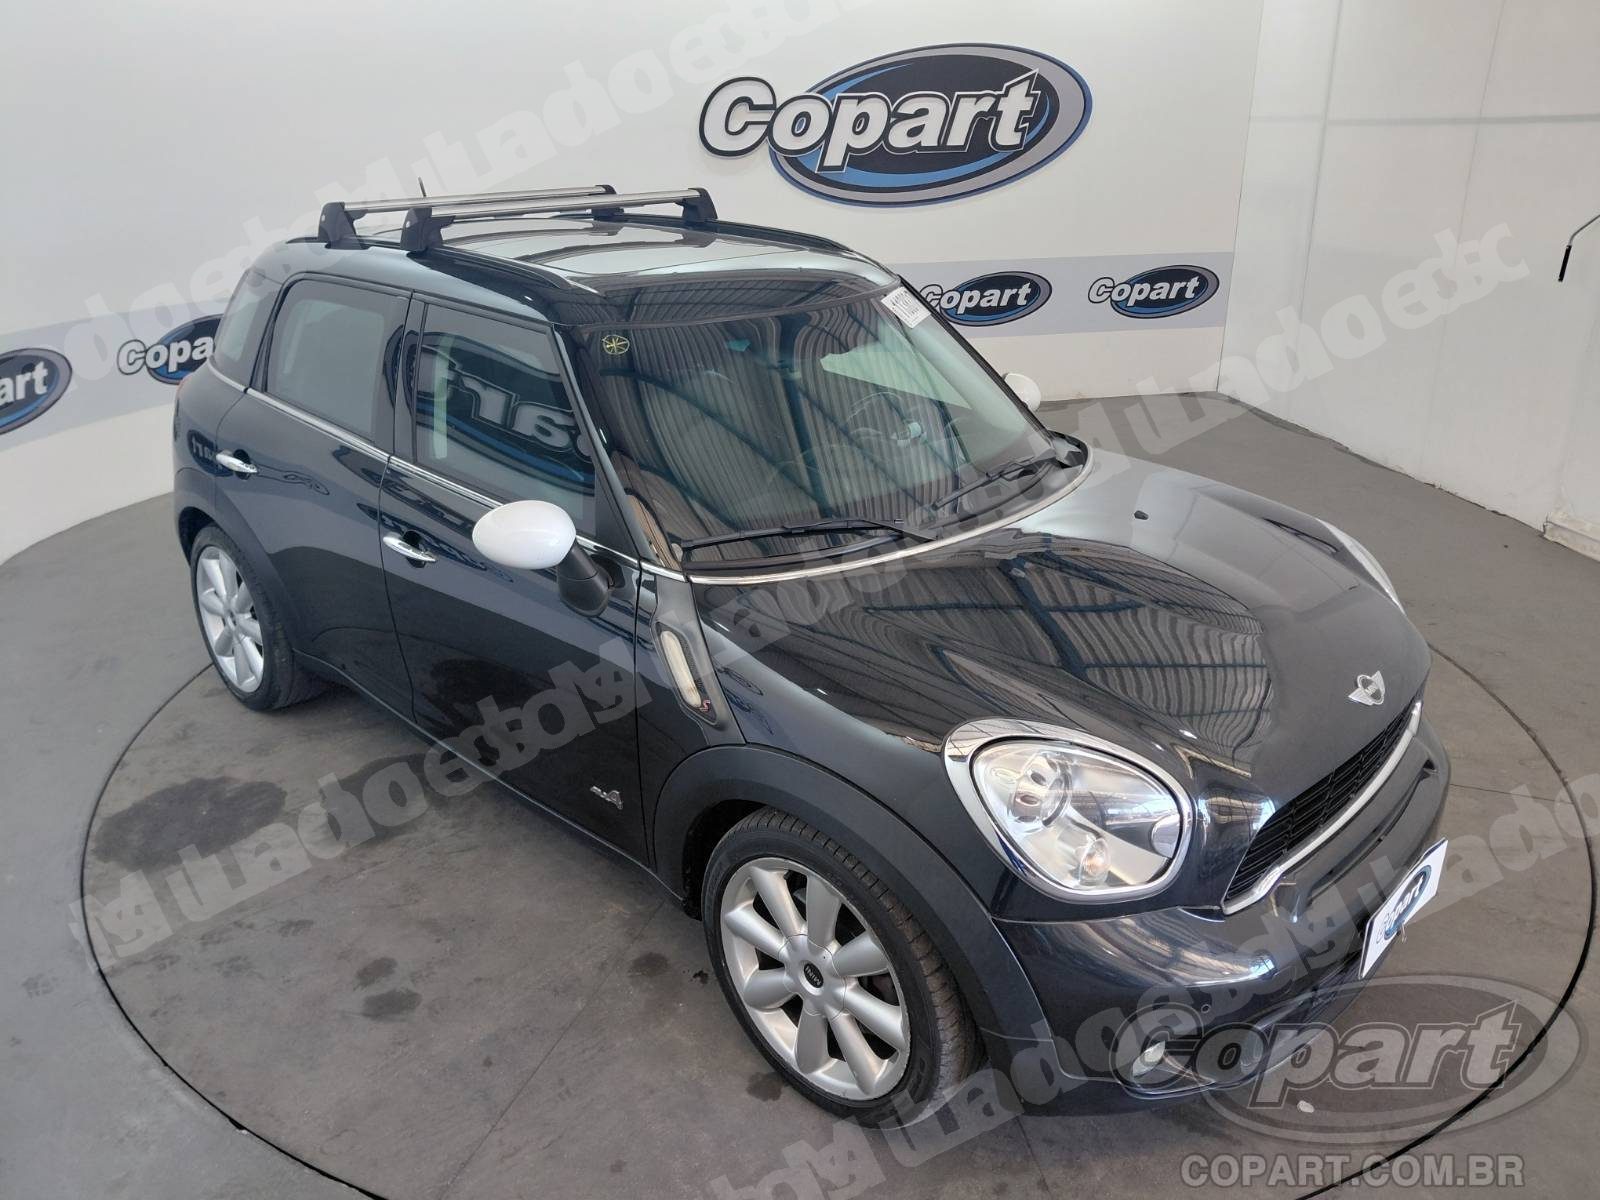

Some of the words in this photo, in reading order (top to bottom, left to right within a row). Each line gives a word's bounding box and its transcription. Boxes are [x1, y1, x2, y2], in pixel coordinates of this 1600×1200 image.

[699, 68, 1041, 173] Copart
[1088, 276, 1200, 307] Copart
[117, 338, 214, 375] Copa
[0, 360, 49, 406] art
